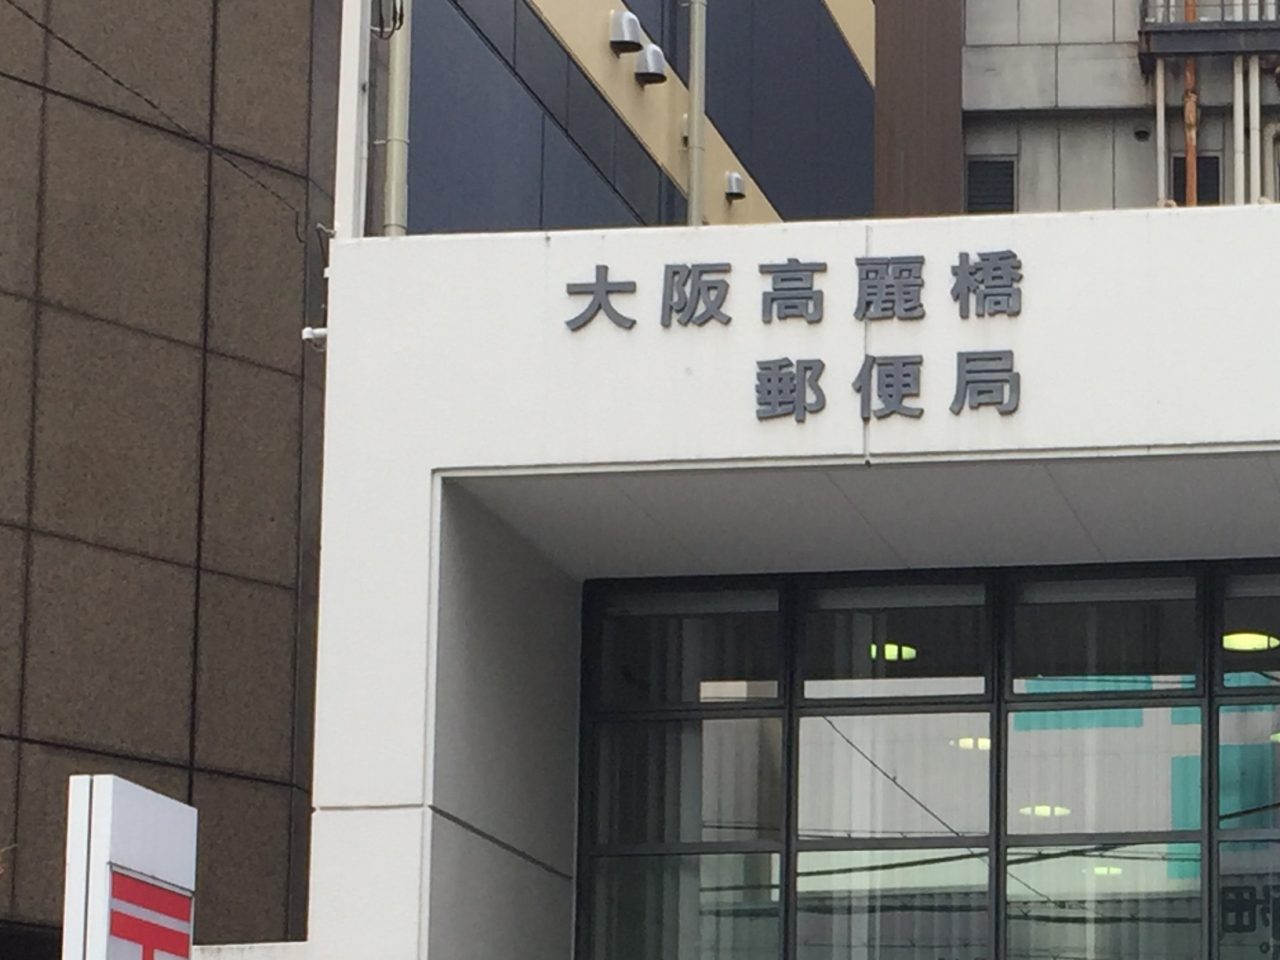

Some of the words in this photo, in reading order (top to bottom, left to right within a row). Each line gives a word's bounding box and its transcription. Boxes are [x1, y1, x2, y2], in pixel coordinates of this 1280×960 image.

[565, 249, 1023, 331] 大阪高麗橋
[754, 350, 1021, 422] 郵便局
